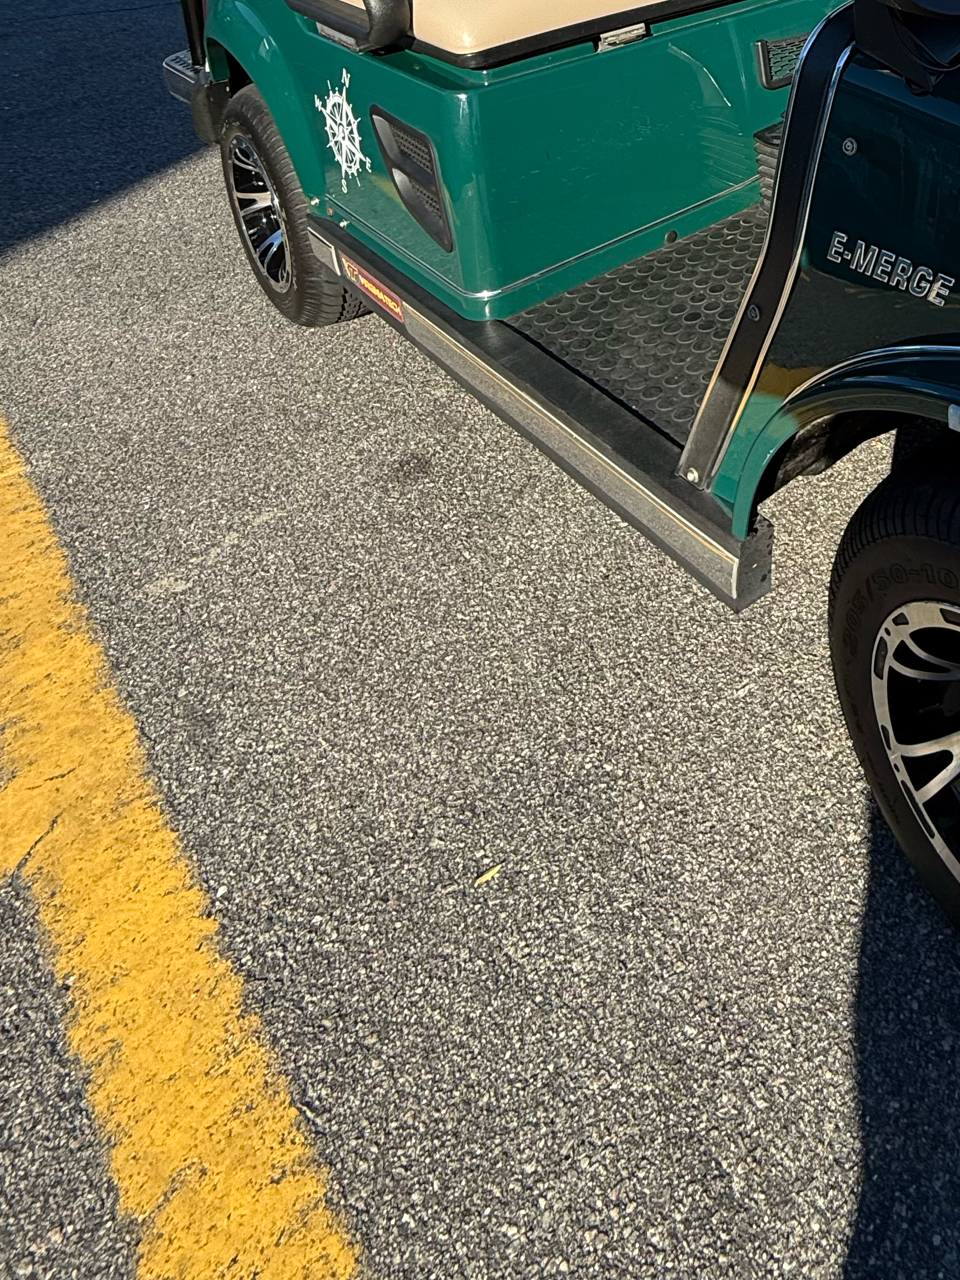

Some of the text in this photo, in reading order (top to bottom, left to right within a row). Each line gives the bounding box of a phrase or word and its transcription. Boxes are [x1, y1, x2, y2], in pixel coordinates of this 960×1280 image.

[341, 67, 351, 88] N
[314, 93, 323, 112] W
[365, 156, 372, 173] E
[341, 178, 348, 193] S
[826, 230, 956, 308] E-MERGE
